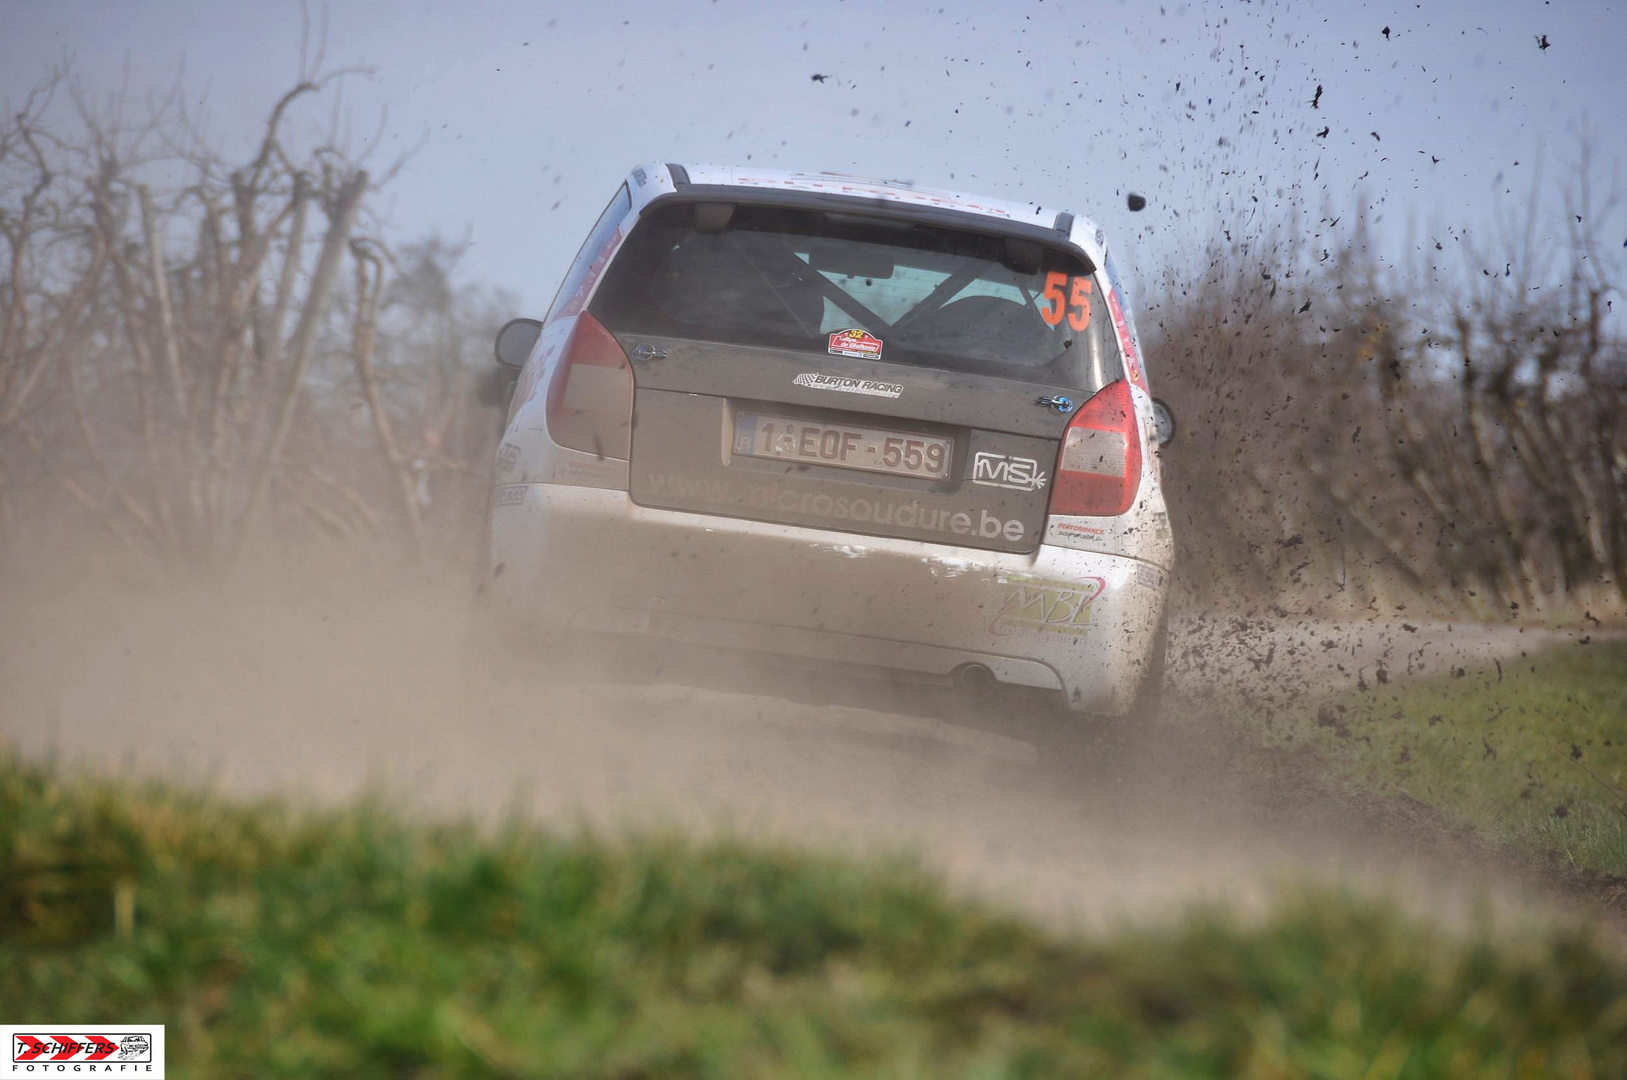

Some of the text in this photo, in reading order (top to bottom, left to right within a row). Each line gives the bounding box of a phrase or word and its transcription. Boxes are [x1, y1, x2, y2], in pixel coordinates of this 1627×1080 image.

[1041, 271, 1092, 332] 55
[849, 330, 864, 339] 32
[815, 375, 903, 394] BURTON RACING
[739, 436, 751, 450] B
[1057, 523, 1104, 535] PERFORMANCE
